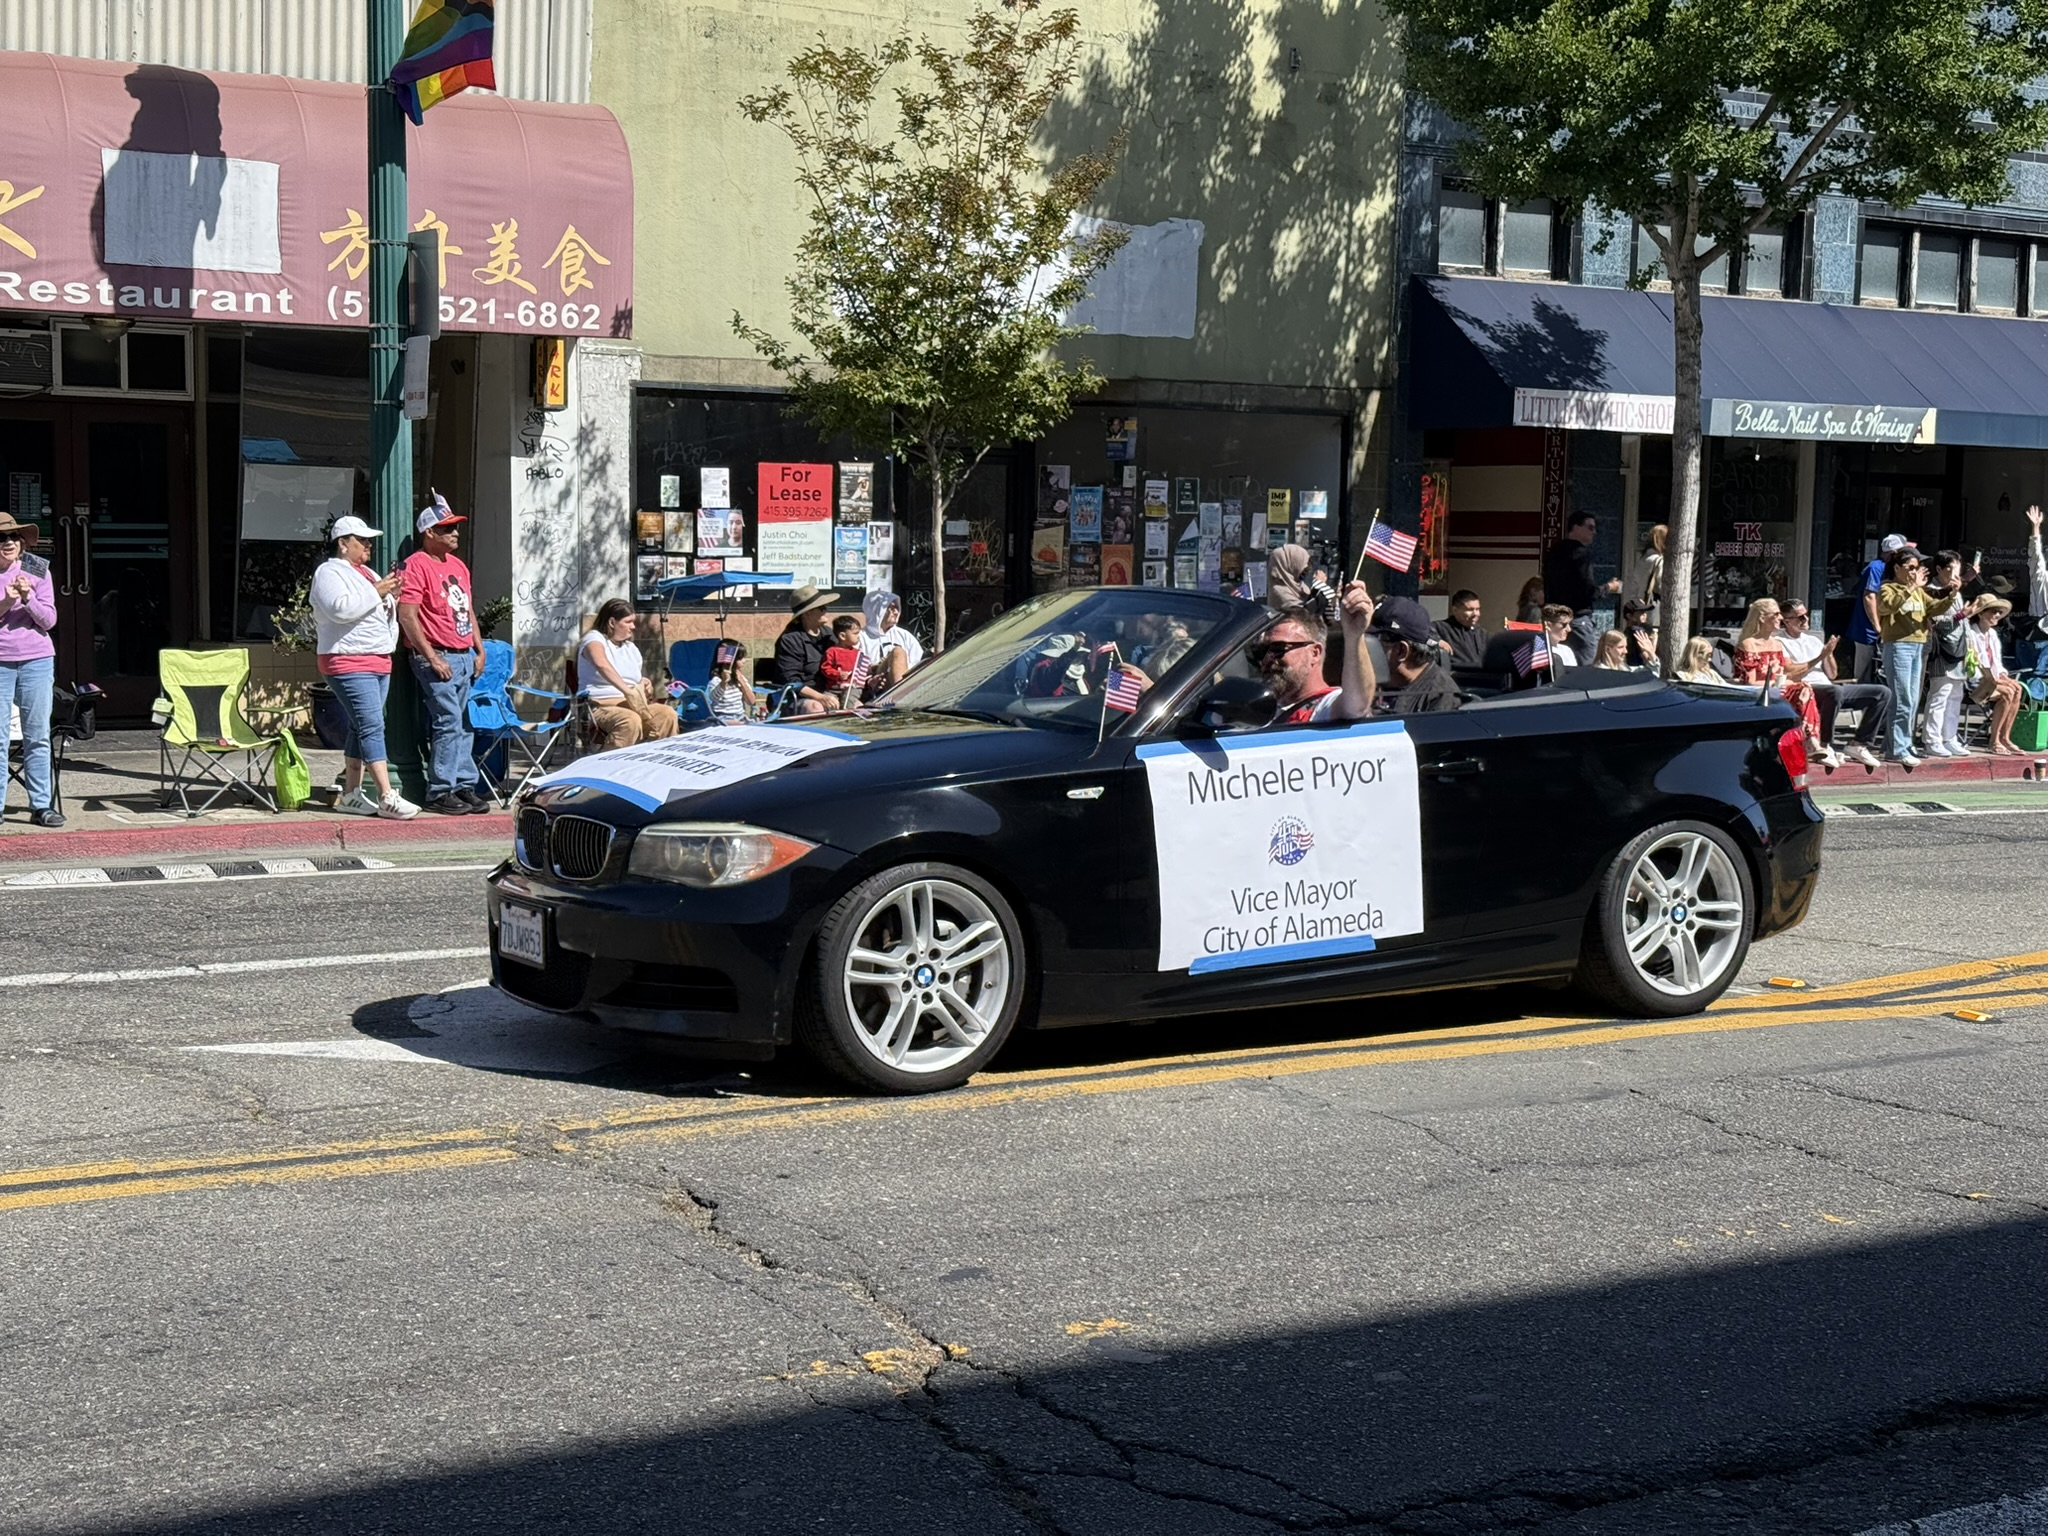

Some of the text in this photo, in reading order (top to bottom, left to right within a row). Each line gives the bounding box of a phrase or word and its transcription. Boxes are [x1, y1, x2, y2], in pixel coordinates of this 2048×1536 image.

[0, 271, 294, 315] Restaurant
[438, 296, 601, 330] 521-6862
[549, 346, 562, 398] ARK
[1520, 395, 1674, 431] LITTLE PSYCHIC SHOP
[1735, 403, 1914, 443] Bella Nail Spa & Waxing
[781, 466, 812, 483] For
[1549, 428, 1562, 494] ORTUNE
[769, 485, 822, 501] Lease
[1271, 492, 1286, 500] IMP
[763, 505, 828, 517] 415.395.7262
[762, 530, 808, 539] Justin Choi
[1733, 522, 1762, 541] TK
[761, 552, 776, 560] Jeff
[1715, 542, 1743, 557] BARBER
[1744, 542, 1763, 557] SHOP
[1771, 543, 1785, 558] SPA
[1188, 756, 1386, 805] Michele Pryor
[1274, 836, 1303, 858] JULY
[1230, 878, 1357, 915] Vice Mayor
[1203, 903, 1384, 954] City of Alameda
